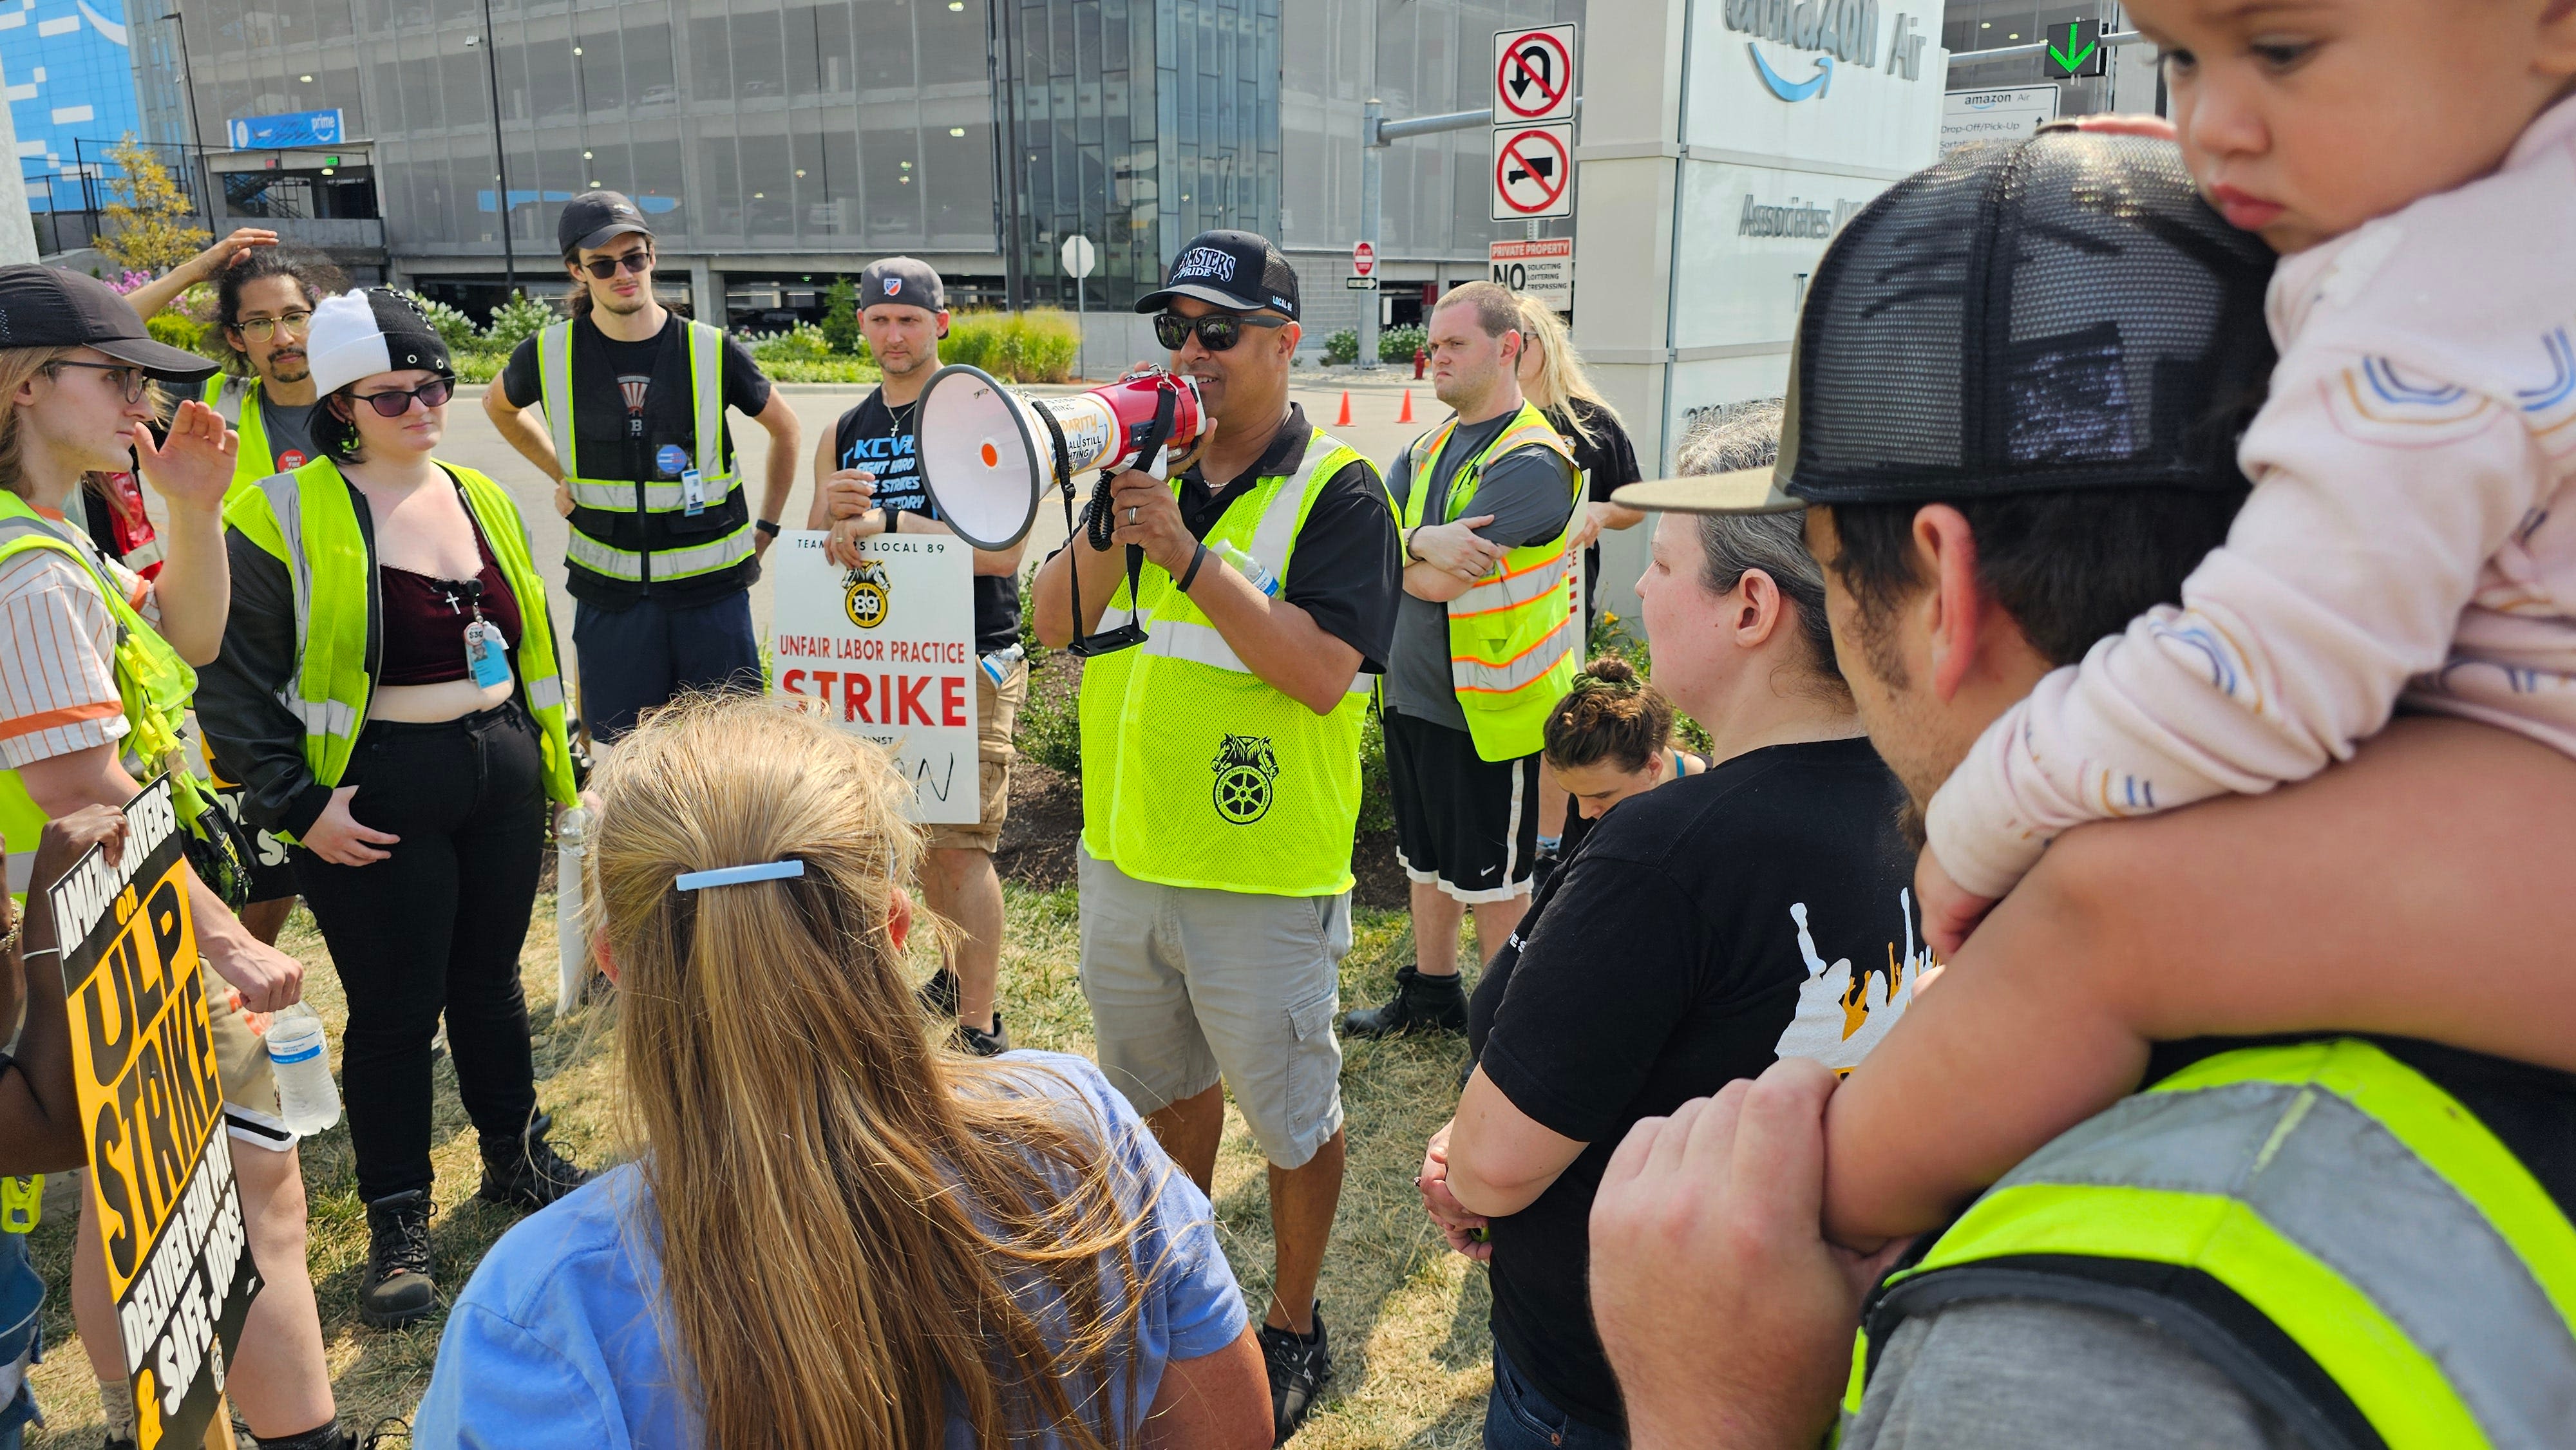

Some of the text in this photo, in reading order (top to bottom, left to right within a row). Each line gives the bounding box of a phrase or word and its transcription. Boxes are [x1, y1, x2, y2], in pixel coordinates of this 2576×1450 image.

[1723, 0, 1927, 81] amazon Air
[1965, 93, 2030, 105] amazon Air
[311, 113, 336, 131] prime
[1941, 122, 2020, 134] Drop-Off/Pick-Up
[1939, 140, 1972, 151] Sortat
[1738, 194, 1831, 239] Associates
[1492, 243, 1568, 257] PRIVATE PROPERTY
[1178, 267, 1212, 279] PRIDE
[1493, 263, 1526, 290] NO
[1273, 295, 1287, 309] LOCAL
[1062, 413, 1097, 434] DARITY
[1069, 436, 1101, 449] ALL STILL
[1068, 449, 1088, 460] HTING
[881, 475, 920, 493] STRIKES
[798, 539, 945, 553] TEAMRS LOCAL 89
[854, 594, 878, 614] 89
[780, 634, 965, 664] UNFAIR LABOR PRACTICE
[783, 669, 967, 727] STRIKE
[53, 779, 177, 961] AMAZON DRIVERS
[115, 883, 138, 925] on
[82, 880, 182, 1088] ULP
[94, 965, 220, 1280] STRIKE
[120, 1114, 232, 1375] DELIVER FAIR PAY
[137, 1180, 245, 1450] & SAFE JOBS!
